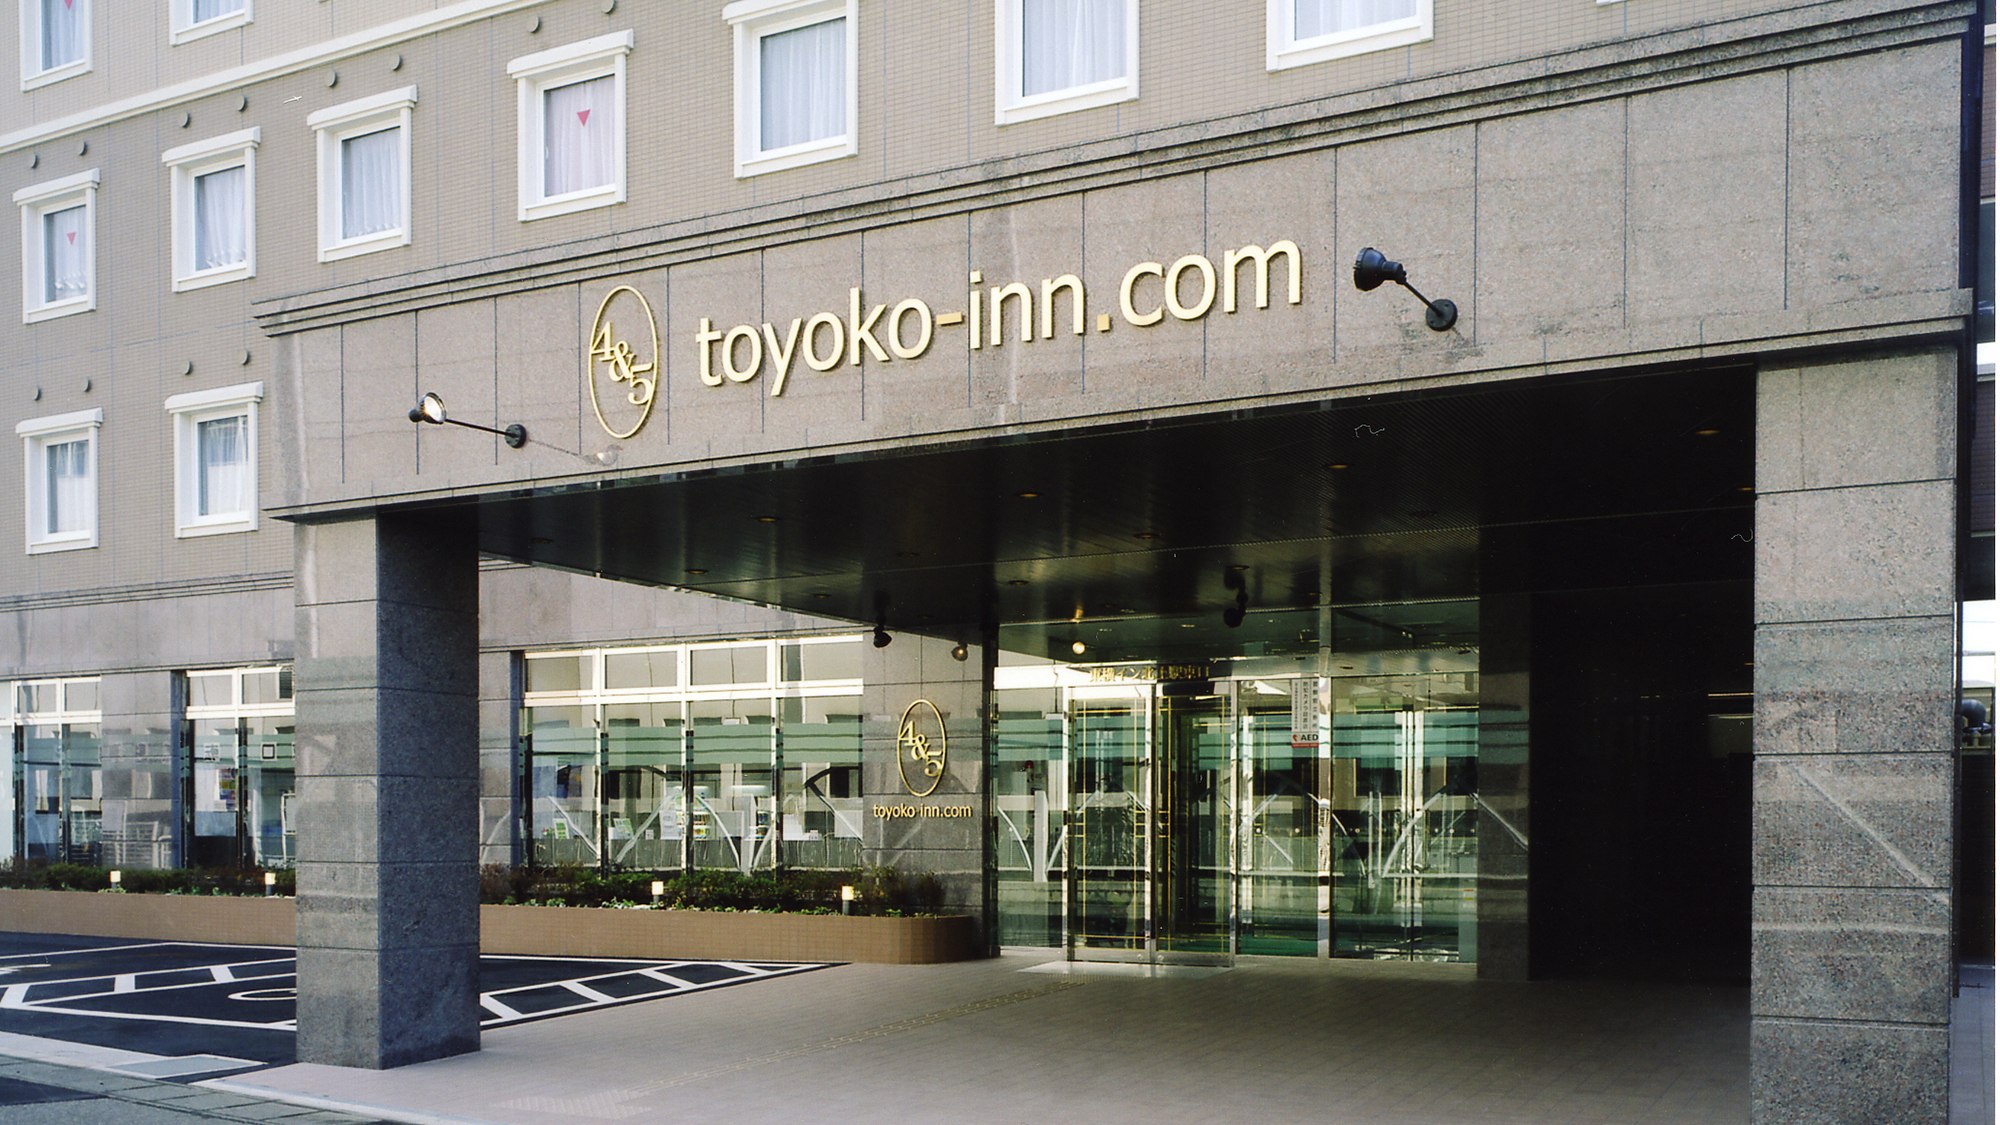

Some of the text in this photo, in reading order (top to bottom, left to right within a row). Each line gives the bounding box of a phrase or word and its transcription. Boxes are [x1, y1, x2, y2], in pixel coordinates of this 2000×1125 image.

[695, 239, 1302, 397] toyoko-inn.com
[590, 322, 655, 405] 4&5
[900, 721, 943, 777] 4&5
